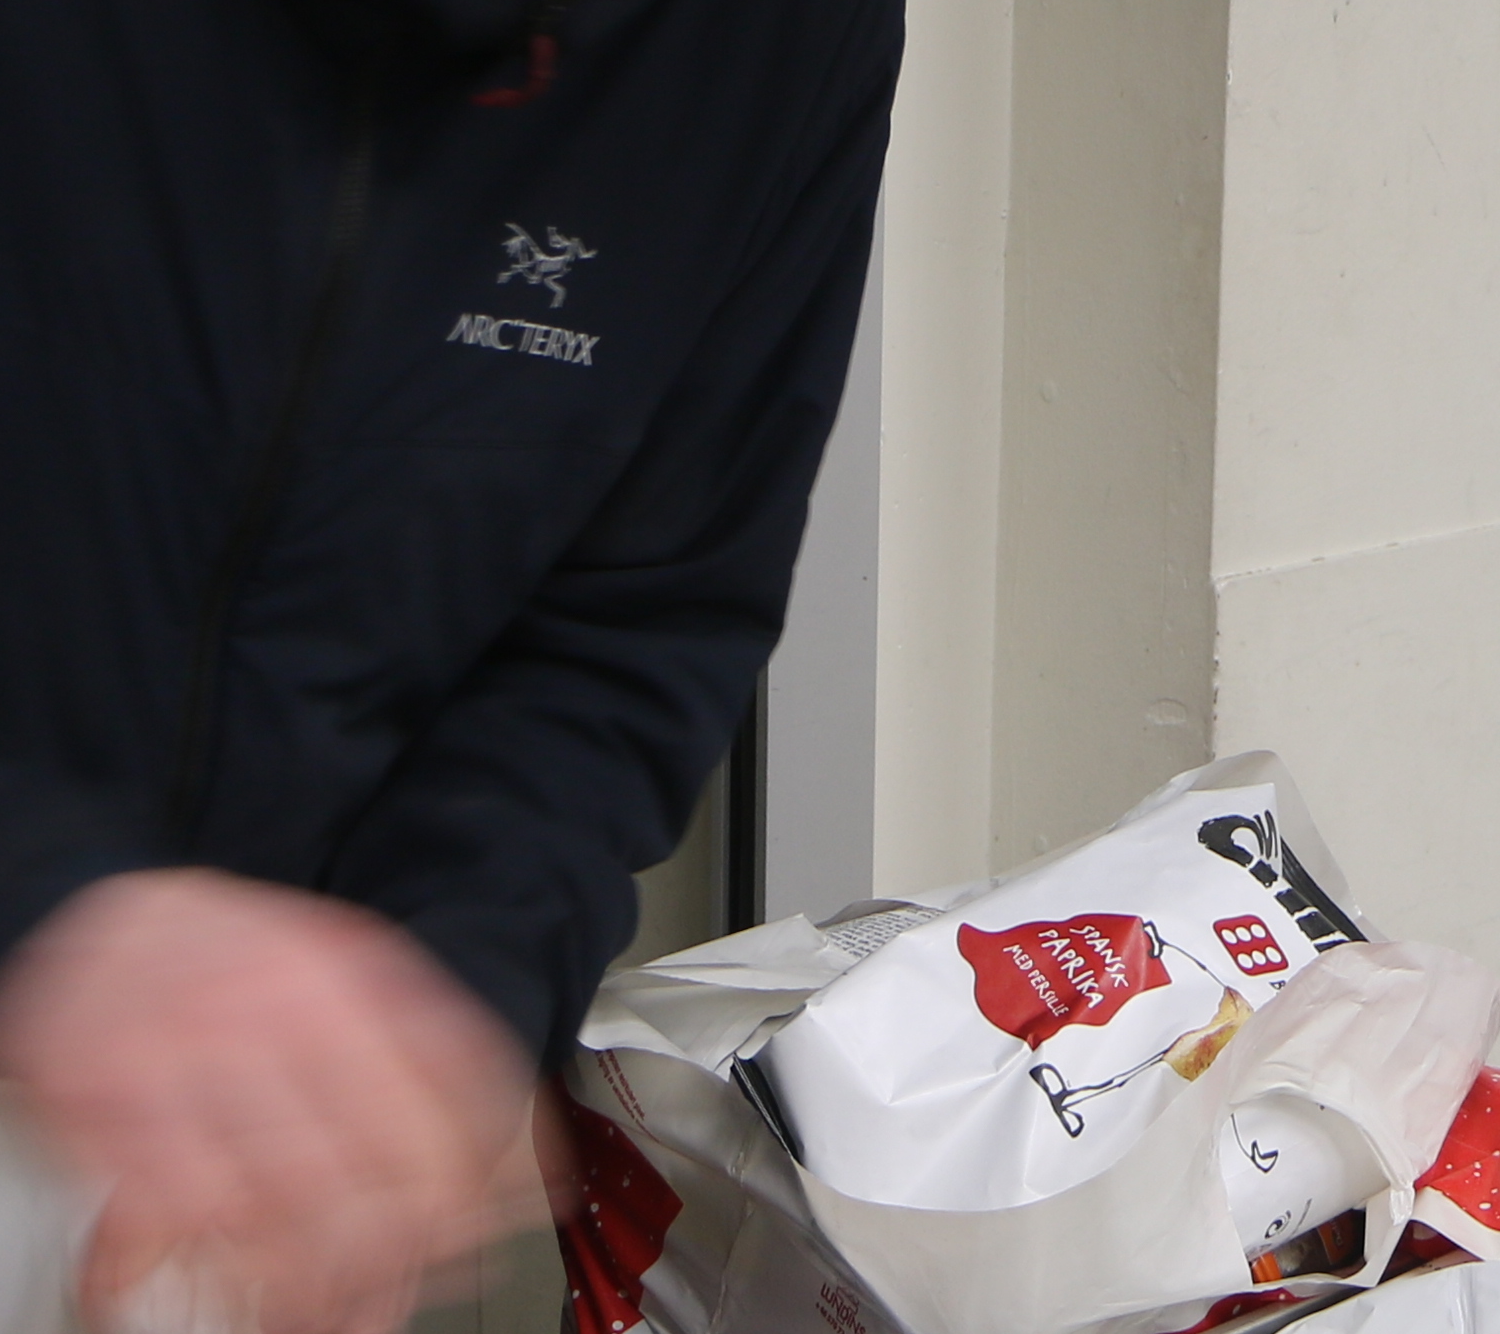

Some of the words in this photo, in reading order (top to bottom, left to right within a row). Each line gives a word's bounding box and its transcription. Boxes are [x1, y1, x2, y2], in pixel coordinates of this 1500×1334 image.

[1003, 943, 1028, 971] MED
[1027, 968, 1070, 1018] PERSILLE
[1037, 927, 1105, 1009] PAPRIKA
[1068, 924, 1130, 989] SPANSK
